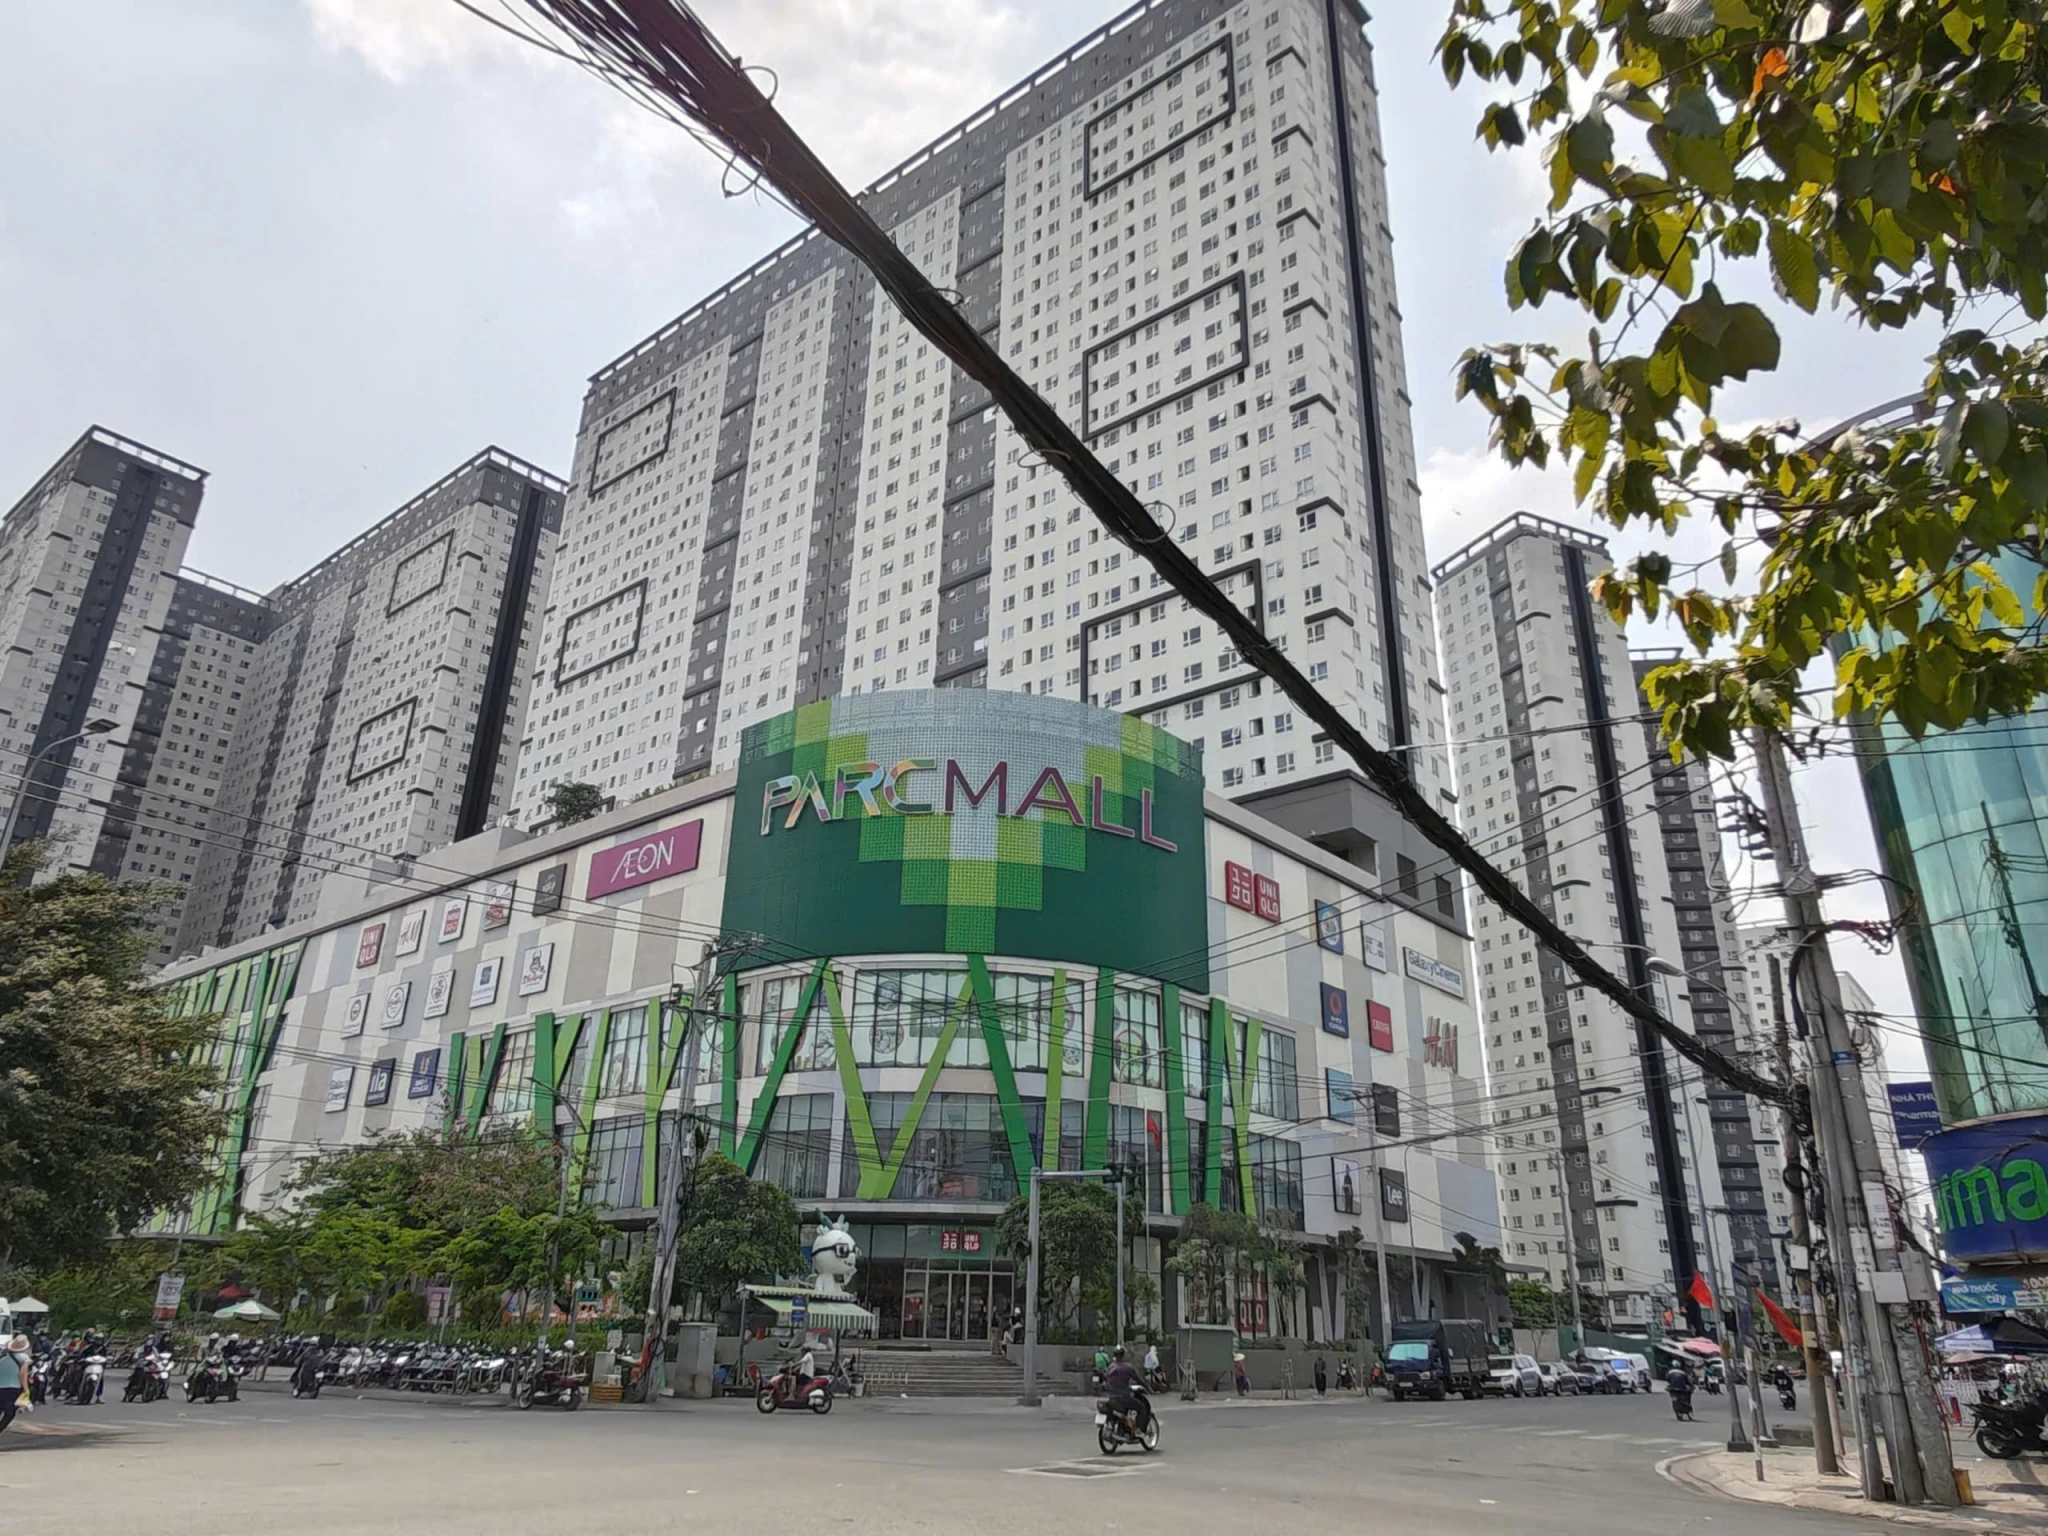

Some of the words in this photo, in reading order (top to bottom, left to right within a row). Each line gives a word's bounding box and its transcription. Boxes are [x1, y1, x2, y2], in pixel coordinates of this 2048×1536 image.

[1259, 879, 1277, 900] UNI
[1260, 896, 1279, 917] QLO
[362, 928, 380, 946] UNI
[360, 944, 378, 962] QLO
[369, 1067, 388, 1094] ila
[1386, 1184, 1403, 1207] Lee
[1935, 1158, 2048, 1234] rma
[963, 1241, 980, 1251] QLO
[964, 1233, 979, 1243] UNI
